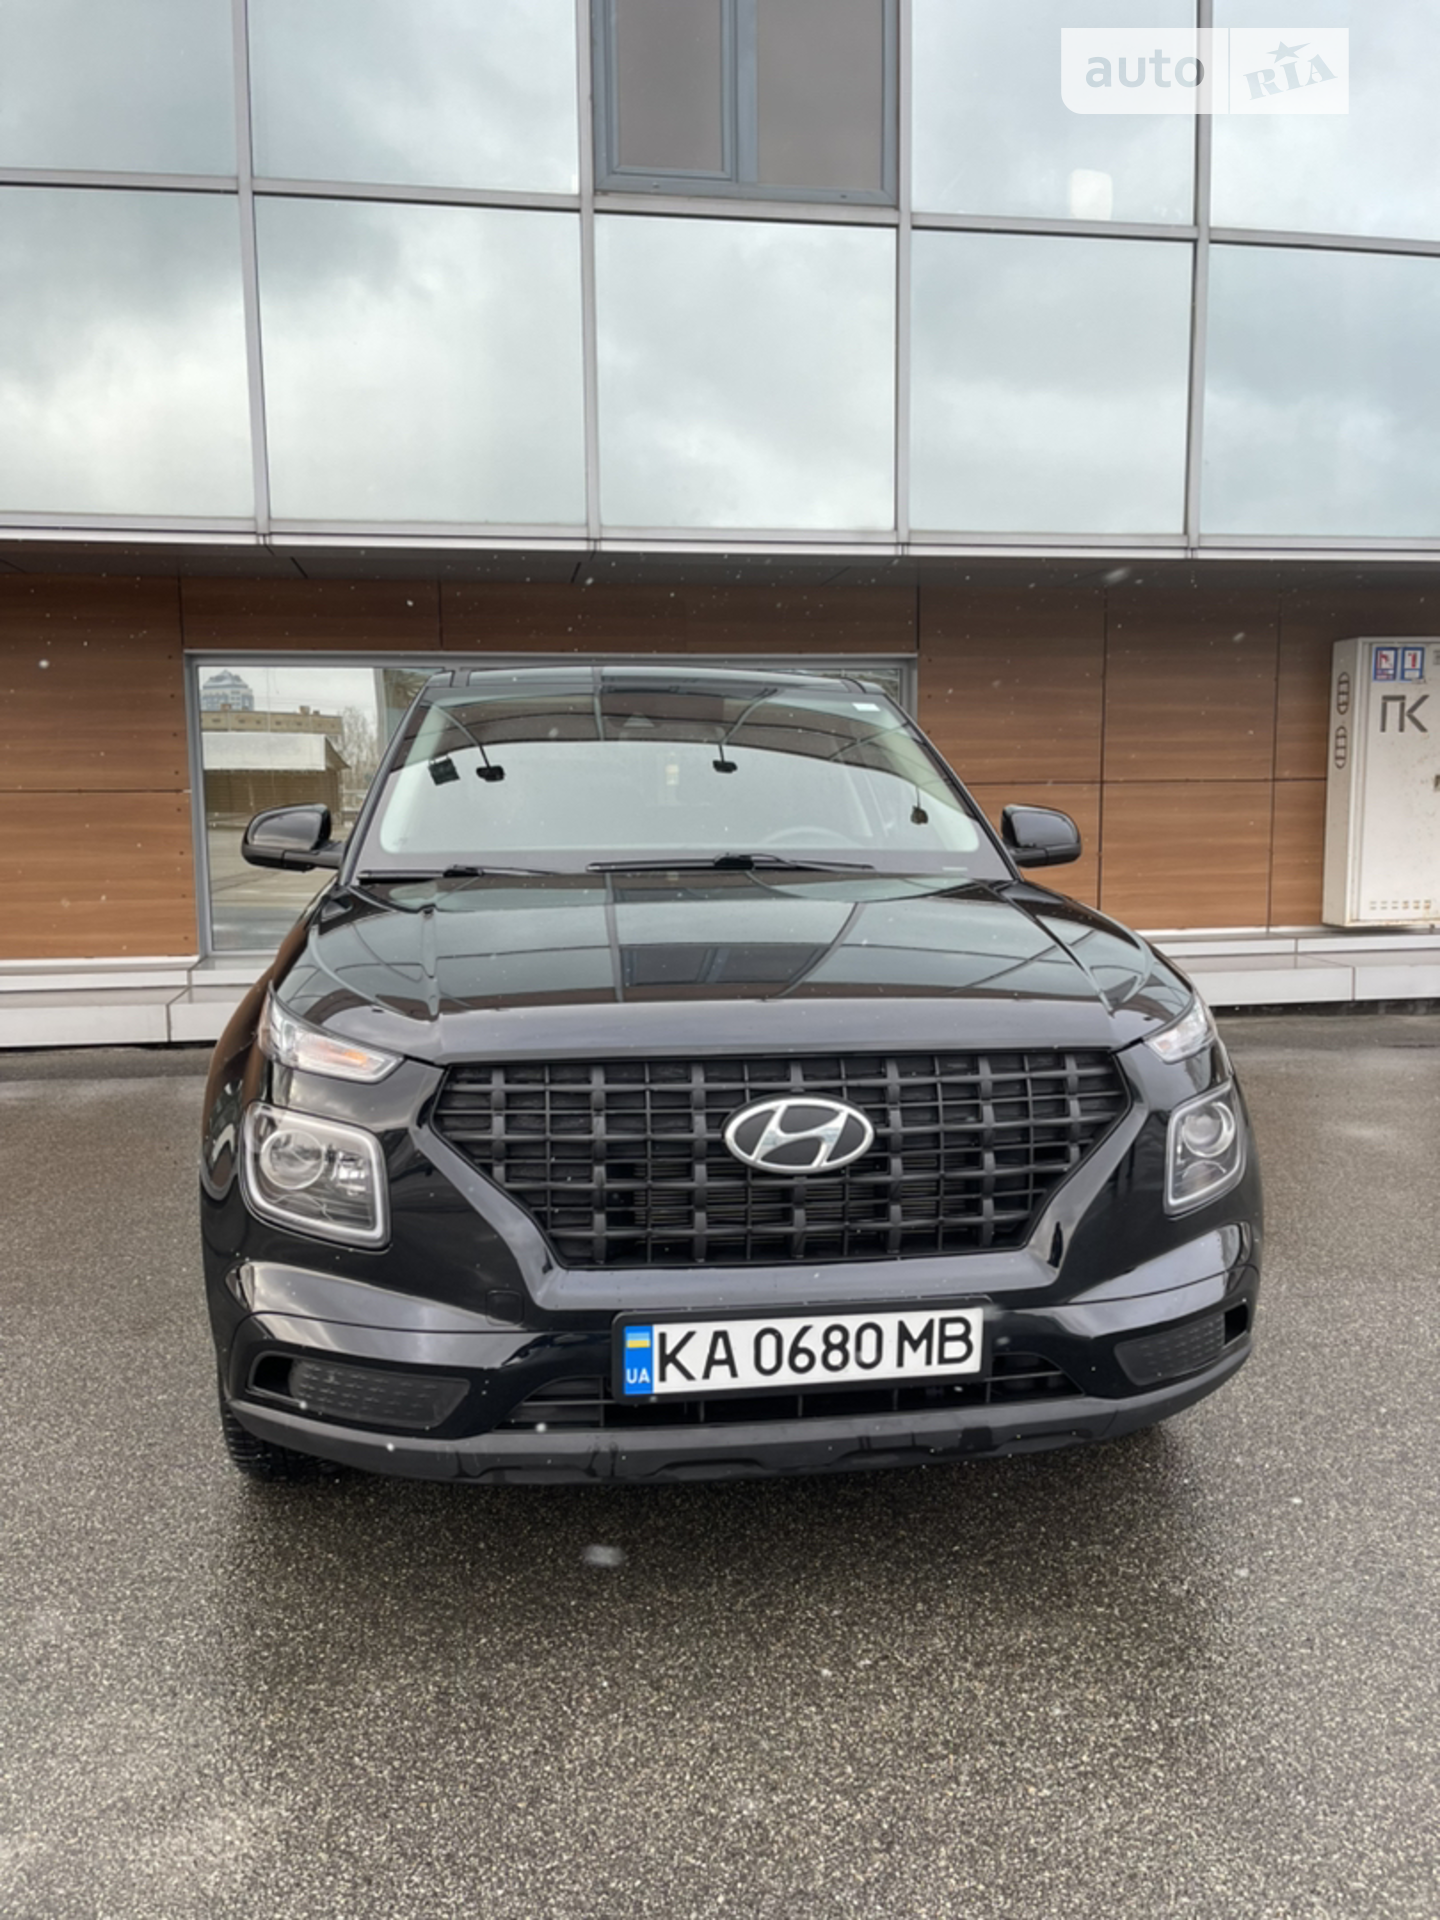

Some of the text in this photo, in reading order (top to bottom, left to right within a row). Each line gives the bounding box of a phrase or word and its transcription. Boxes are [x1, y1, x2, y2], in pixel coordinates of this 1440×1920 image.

[1380, 694, 1430, 733] ПК
[657, 1315, 974, 1383] KA 0680 MB
[626, 1368, 650, 1384] UA
